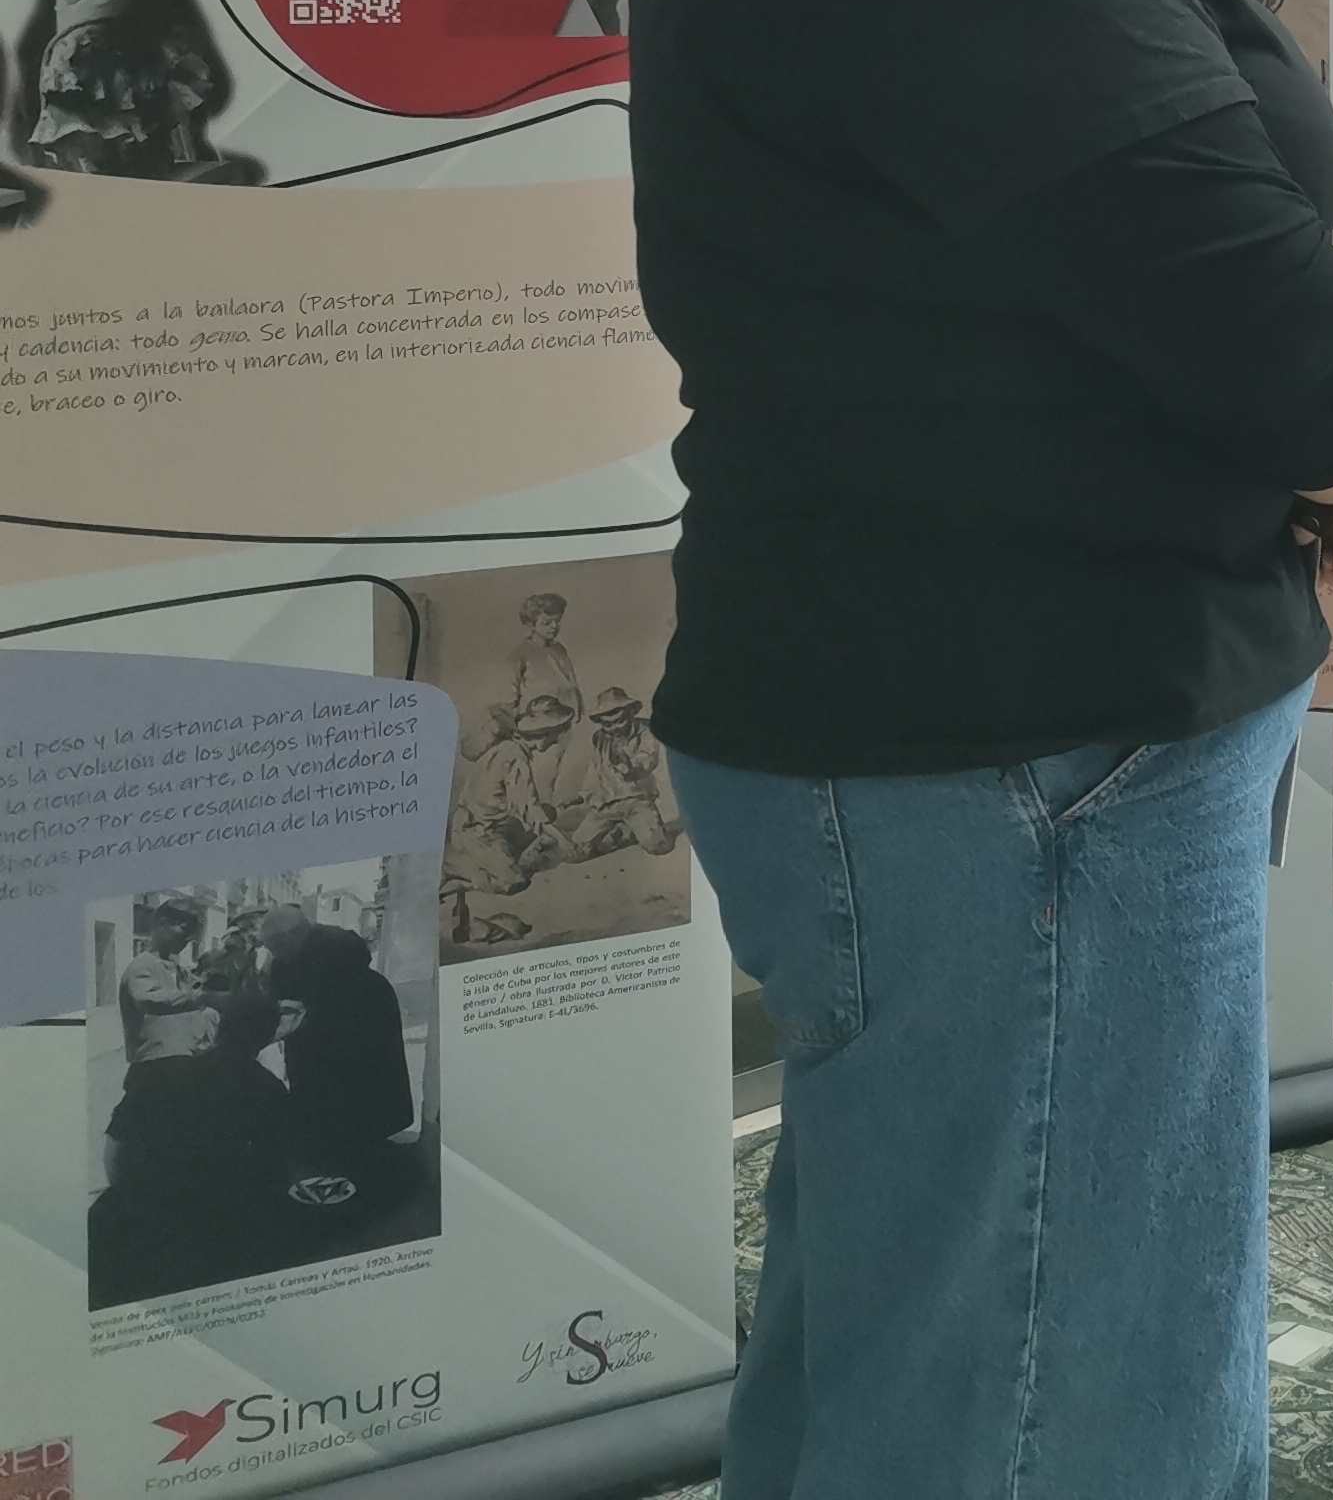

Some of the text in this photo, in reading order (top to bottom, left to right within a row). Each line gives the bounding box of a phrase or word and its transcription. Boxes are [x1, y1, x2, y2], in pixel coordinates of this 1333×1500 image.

[235, 1370, 443, 1443] Simurg
[144, 1407, 443, 1493] Fondos digitalizados del CSIC
